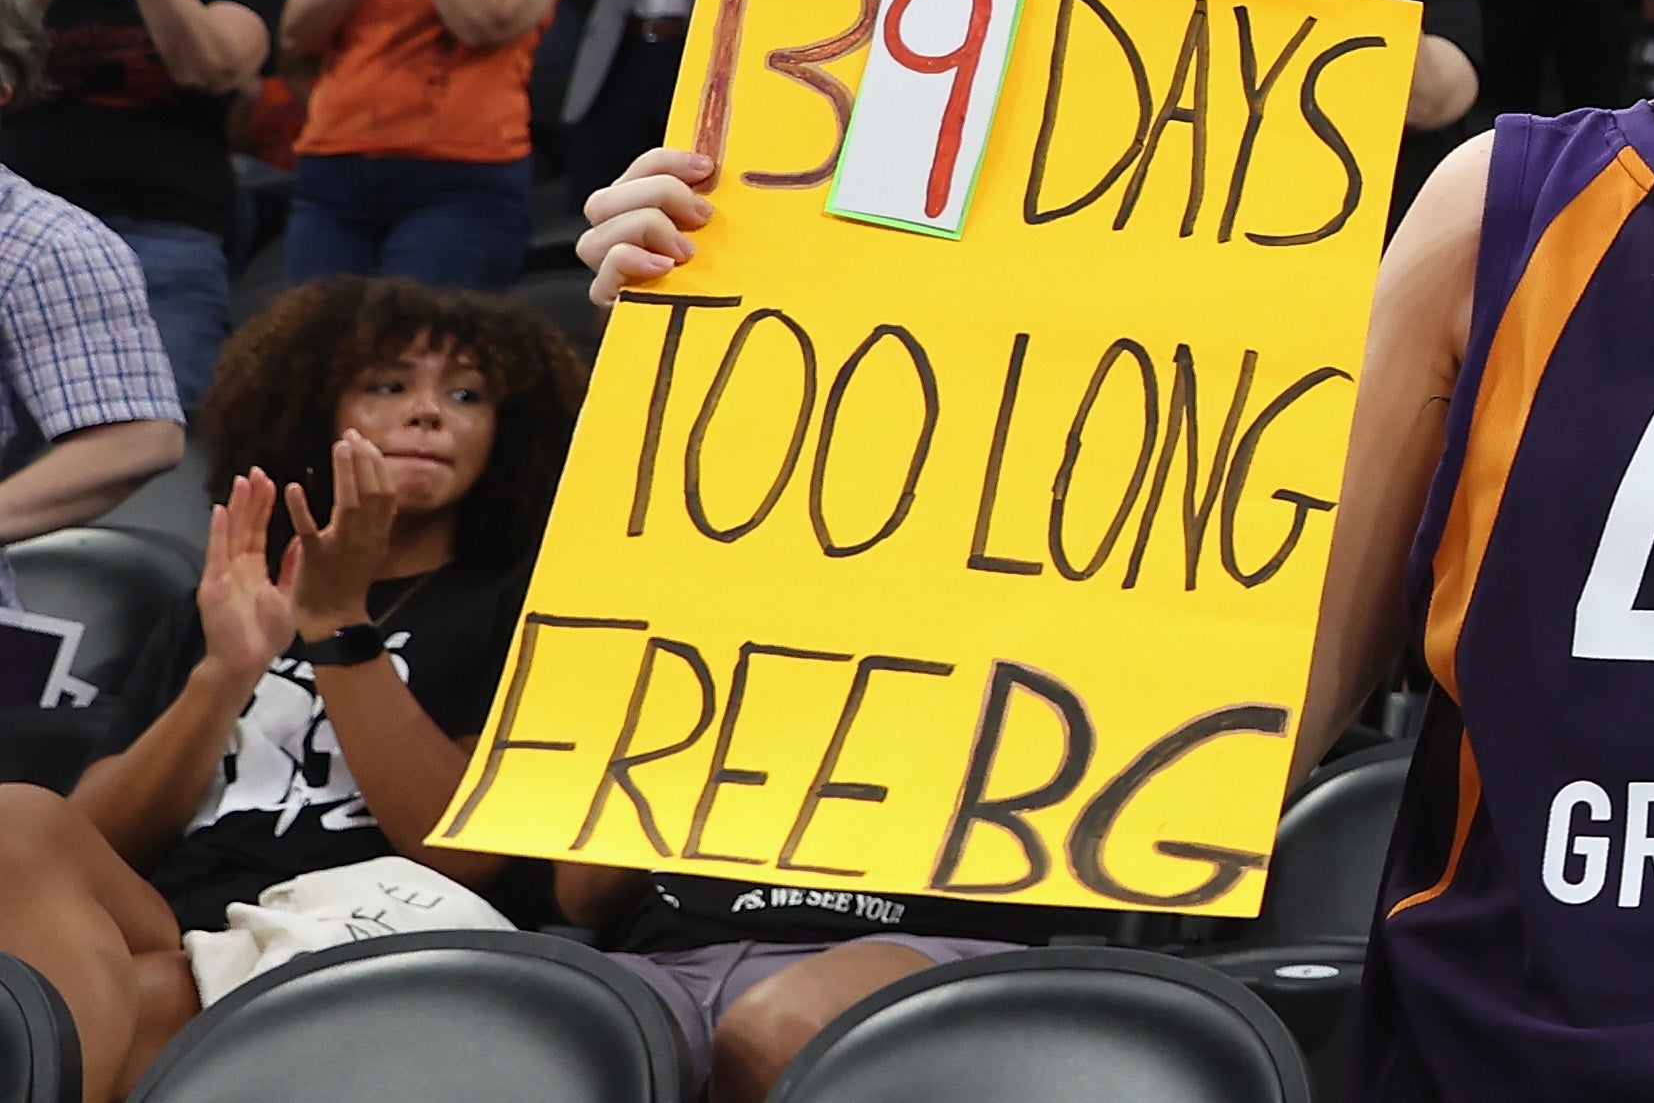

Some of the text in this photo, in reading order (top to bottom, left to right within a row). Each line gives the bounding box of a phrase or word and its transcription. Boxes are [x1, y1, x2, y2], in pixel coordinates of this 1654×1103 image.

[619, 290, 1354, 592] TOO LONG
[443, 611, 956, 877] FREE
[924, 657, 1292, 909] BG
[805, 890, 853, 913] SEE
